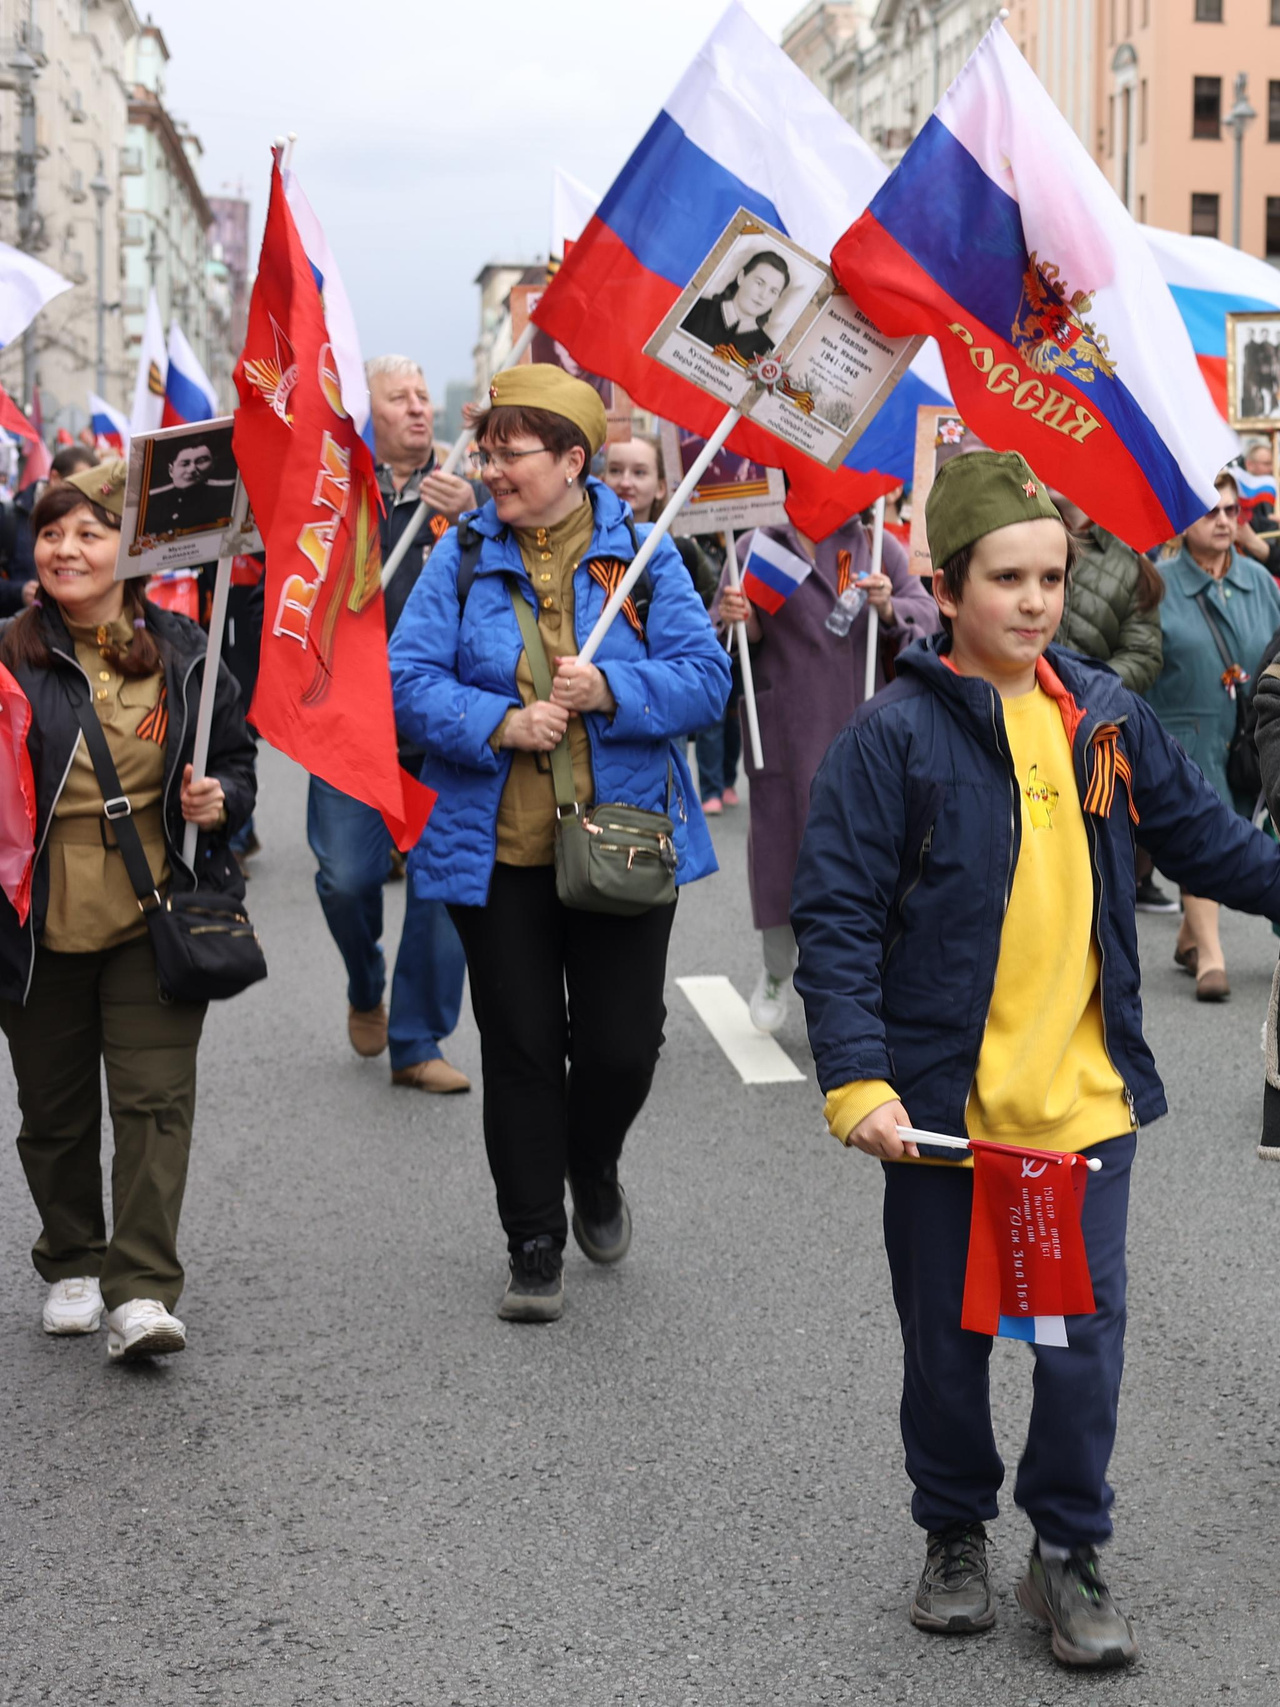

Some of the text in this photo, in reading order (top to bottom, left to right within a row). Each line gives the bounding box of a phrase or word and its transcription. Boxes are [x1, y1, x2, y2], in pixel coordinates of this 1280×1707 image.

[827, 308, 896, 358] Анатолий Иванович
[838, 332, 869, 356] Павлов
[671, 349, 694, 368] Вера
[693, 362, 734, 393] Ивановна
[687, 346, 731, 378] Кузнецова
[819, 349, 861, 380] 1941-1945
[820, 336, 873, 374] Илья Иванович
[947, 322, 1102, 444] РОССИЯ
[778, 402, 825, 436] Вечная слава
[779, 415, 813, 440] солдатам
[1043, 1186, 1054, 1202] 150
